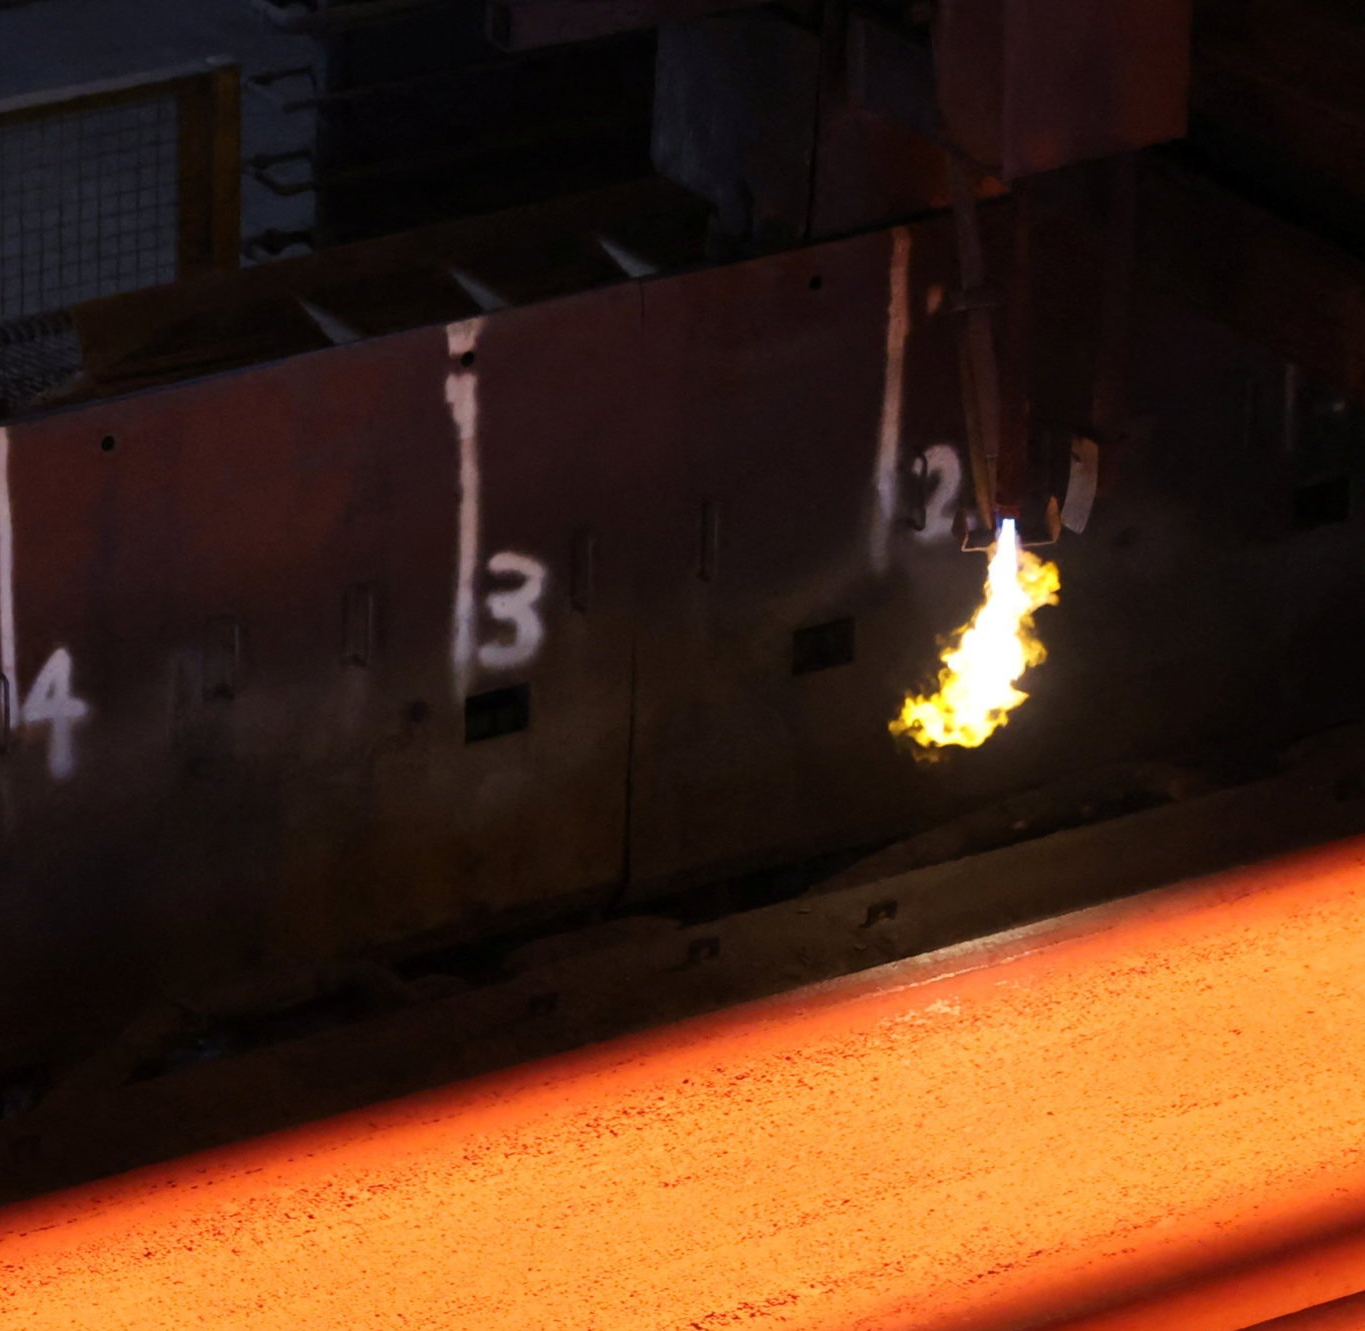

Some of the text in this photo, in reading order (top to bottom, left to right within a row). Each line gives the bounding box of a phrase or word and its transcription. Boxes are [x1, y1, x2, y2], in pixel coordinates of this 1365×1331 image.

[911, 443, 973, 544] 2
[475, 549, 549, 671] 3
[19, 645, 93, 781] 4
